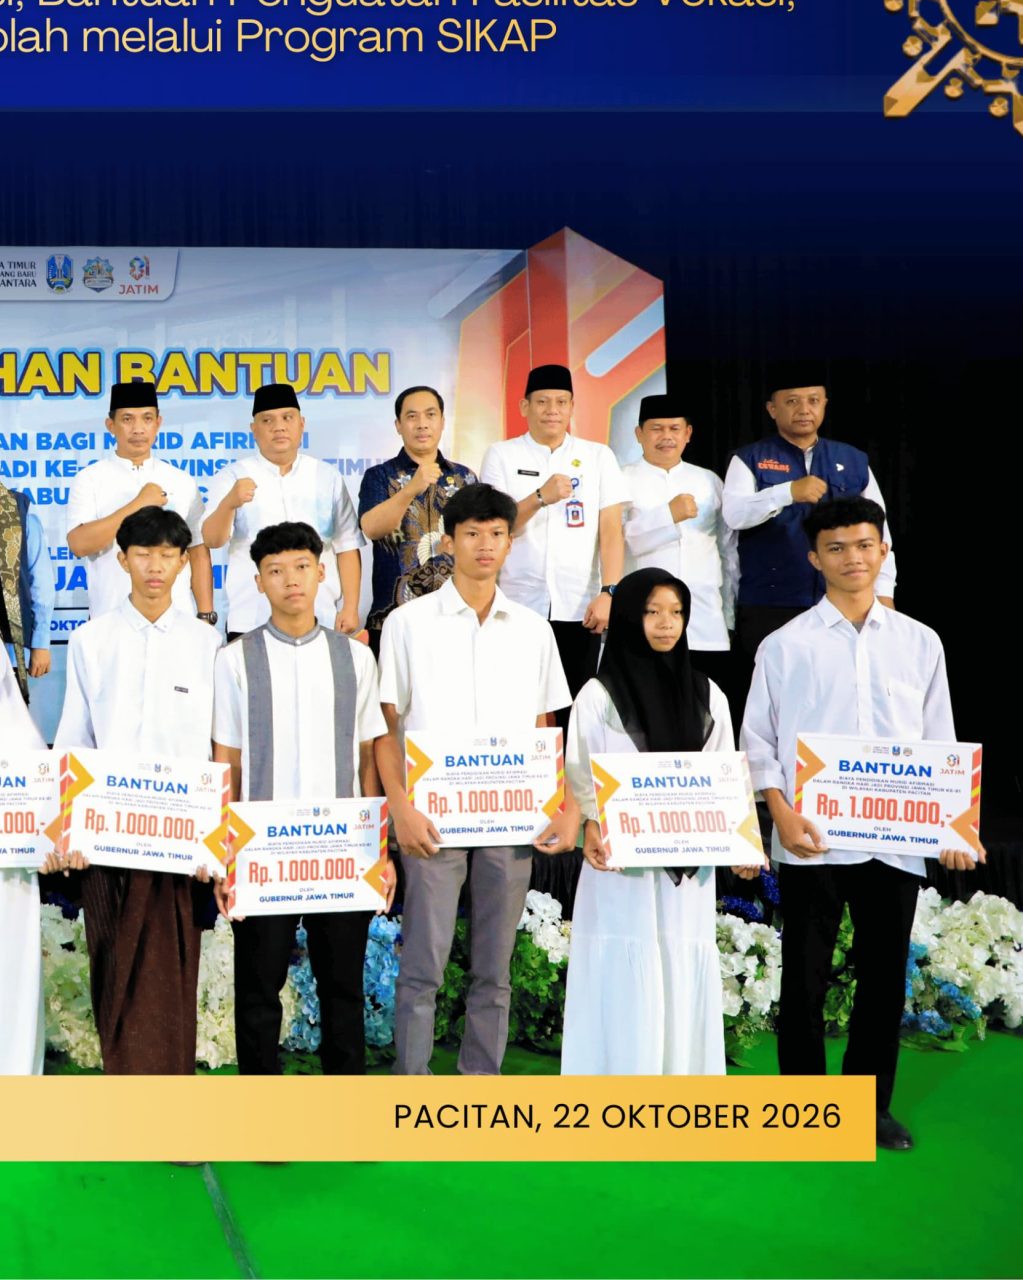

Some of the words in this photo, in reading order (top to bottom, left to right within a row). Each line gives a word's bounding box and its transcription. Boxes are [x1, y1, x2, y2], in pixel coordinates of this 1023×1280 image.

[8, 261, 36, 270] TIMUR
[119, 284, 159, 295] JATIM
[119, 351, 392, 396] BANTUAN
[36, 432, 96, 450] BAGI
[445, 754, 524, 767] BANTUAN
[839, 760, 932, 777] BANTUAN
[107, 776, 188, 794] BANTUAN
[632, 776, 711, 788] BANTUAN
[428, 792, 452, 817] Rp.
[457, 789, 543, 813] 1.000.000,-
[817, 794, 843, 819] Rp.
[850, 796, 952, 827] 1.000.000,-
[85, 808, 108, 835] Rp.
[116, 811, 205, 843] 1.000.000,-
[267, 824, 347, 838] BANTUAN
[619, 812, 645, 837] Rp.
[648, 810, 736, 835] 1.000.000,-
[828, 830, 877, 839] GUBERNUR
[880, 834, 906, 842] JAWA
[910, 837, 939, 845] TIMUR
[94, 845, 139, 855] GUBERNUR
[142, 850, 164, 858] JAWA
[249, 862, 272, 886] Rp.
[278, 858, 365, 881] 1.000.000,-
